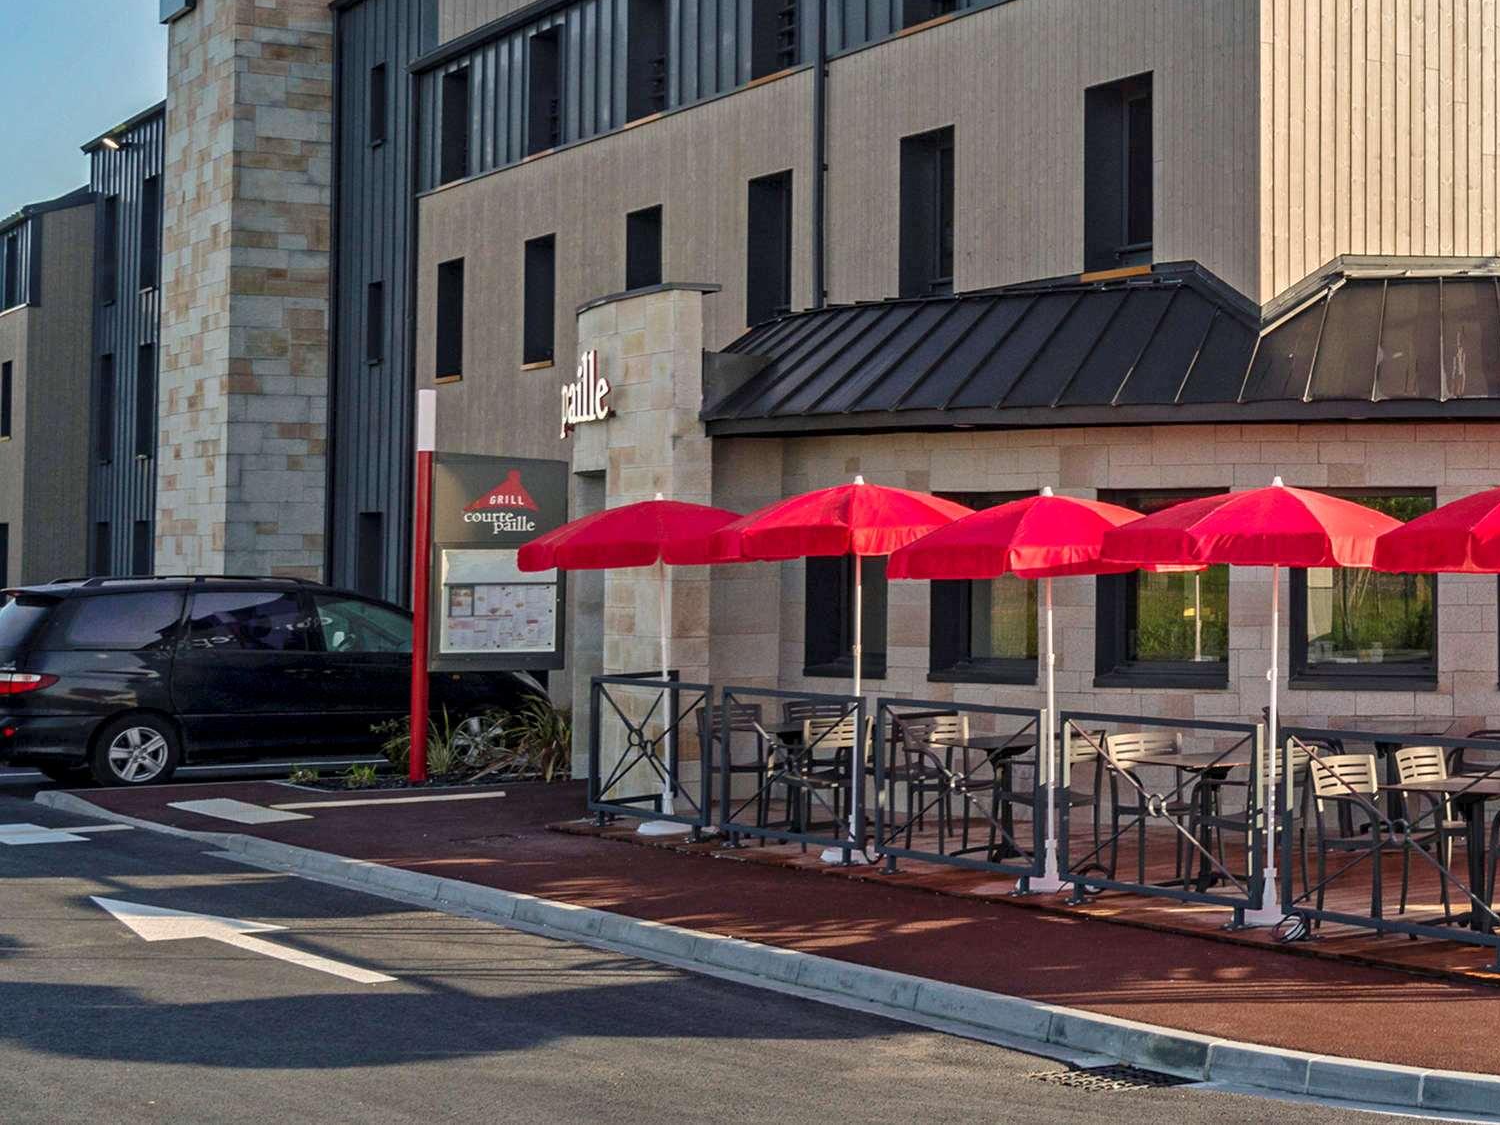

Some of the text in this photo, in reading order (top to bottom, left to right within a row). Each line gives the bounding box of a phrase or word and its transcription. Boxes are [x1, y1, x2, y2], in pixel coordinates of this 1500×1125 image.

[560, 350, 610, 440] paille
[489, 494, 525, 506] GRILL
[463, 511, 514, 523] courte
[492, 516, 536, 535] paille
